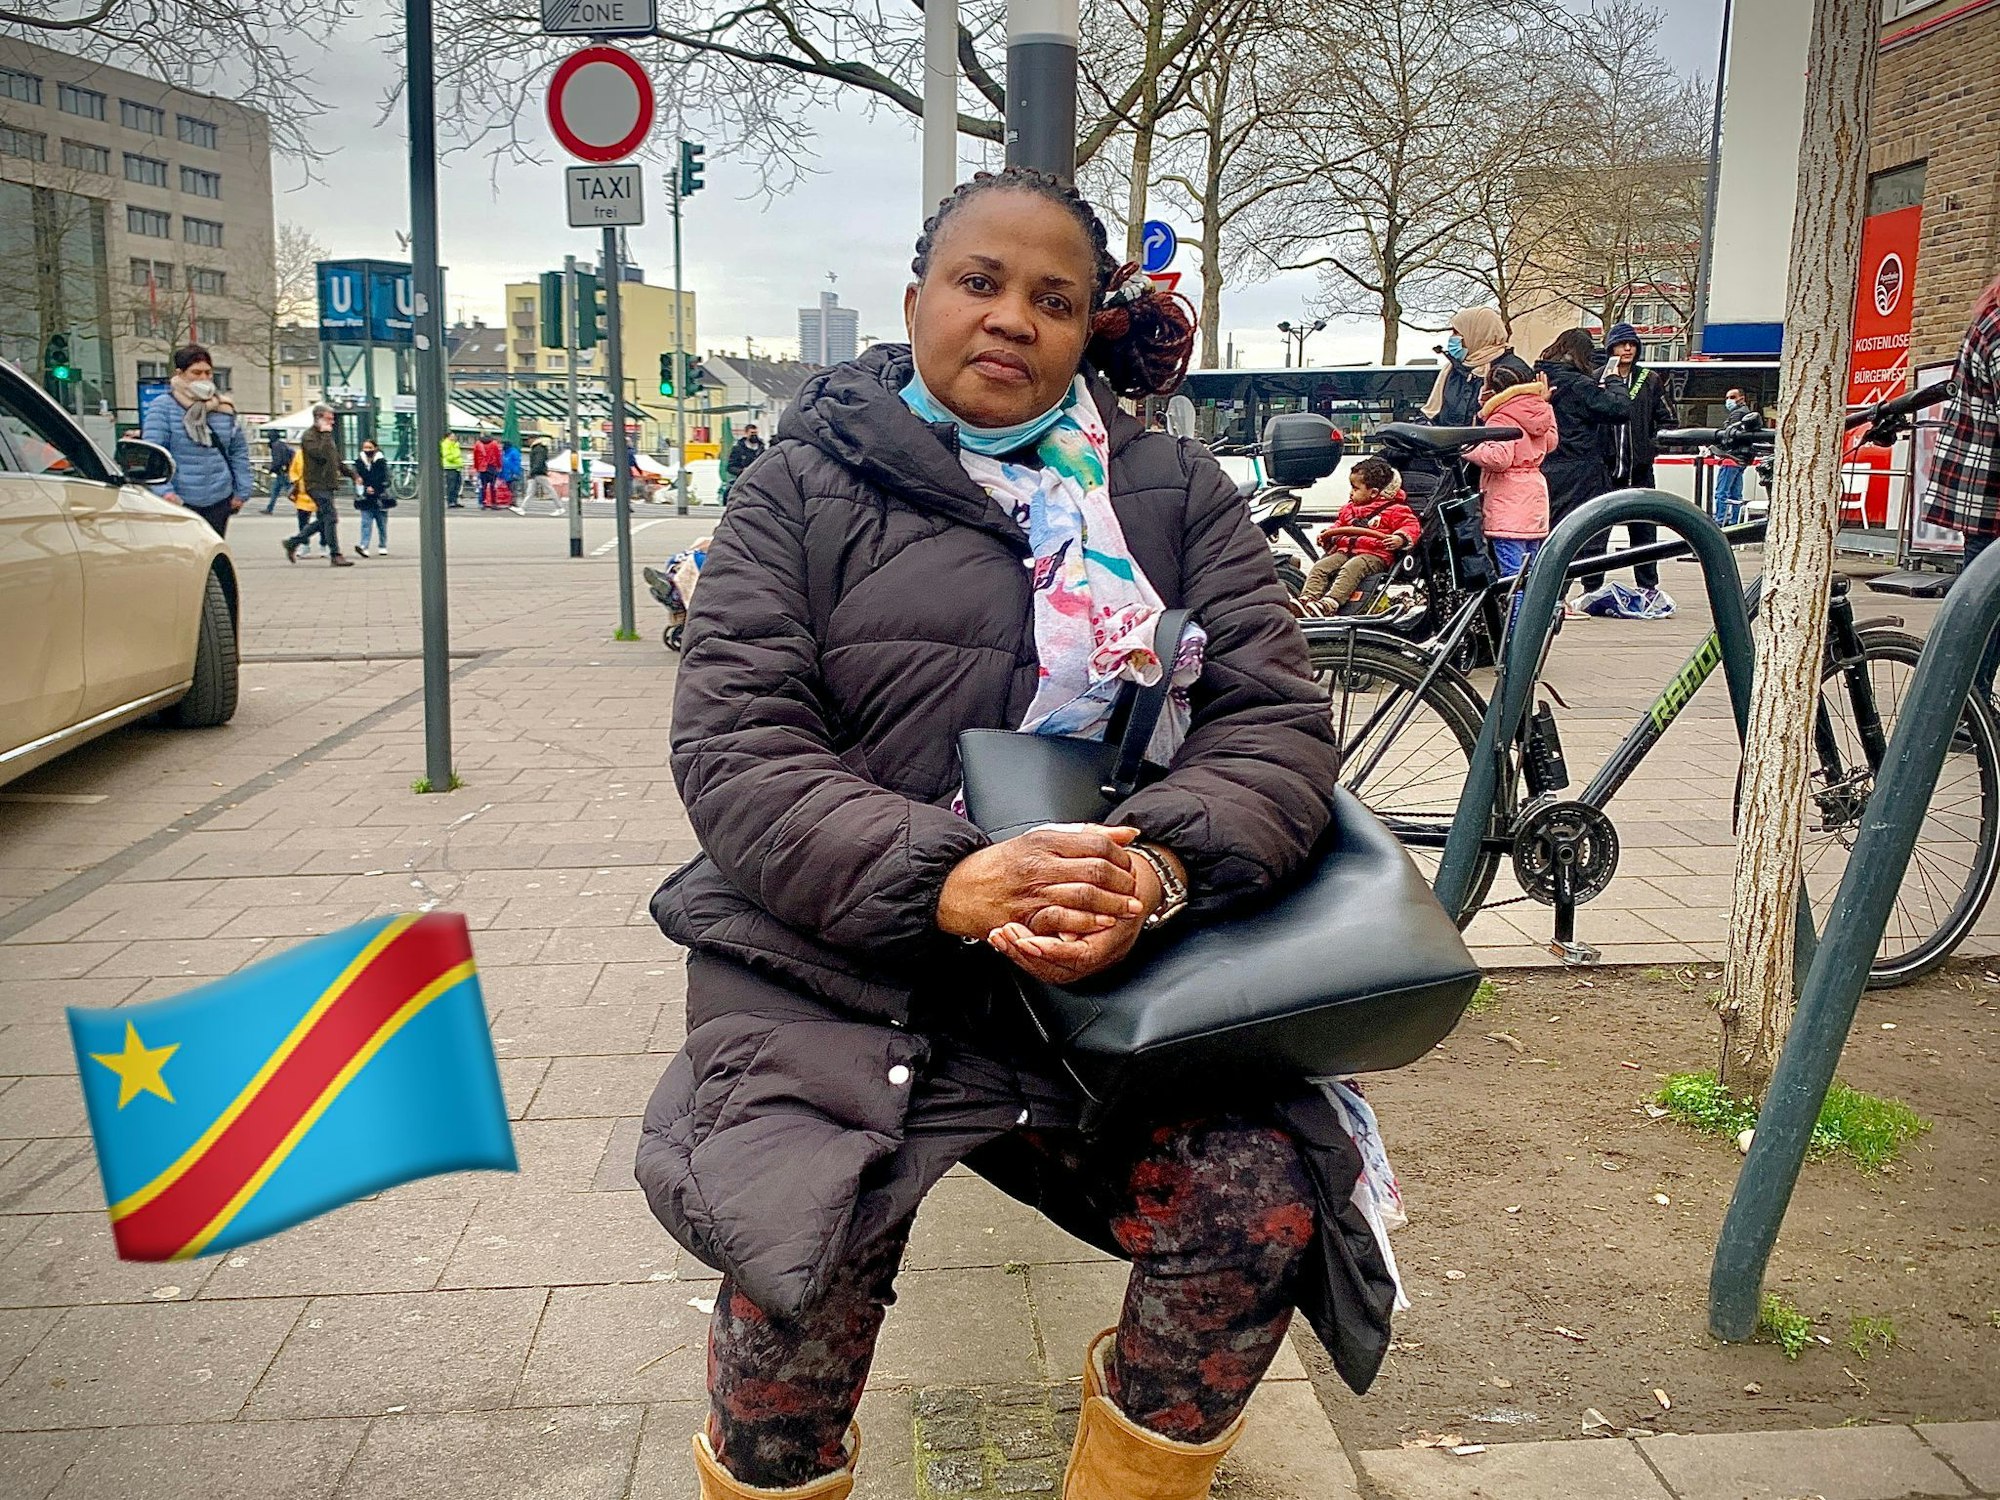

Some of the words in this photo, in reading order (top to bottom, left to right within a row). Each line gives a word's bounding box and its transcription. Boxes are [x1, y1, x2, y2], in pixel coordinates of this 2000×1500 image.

[570, 3, 624, 23] ZONE
[576, 176, 631, 200] TAXI
[594, 206, 618, 218] frei
[331, 275, 352, 313] U
[1855, 333, 1910, 353] KOSTENLOSE
